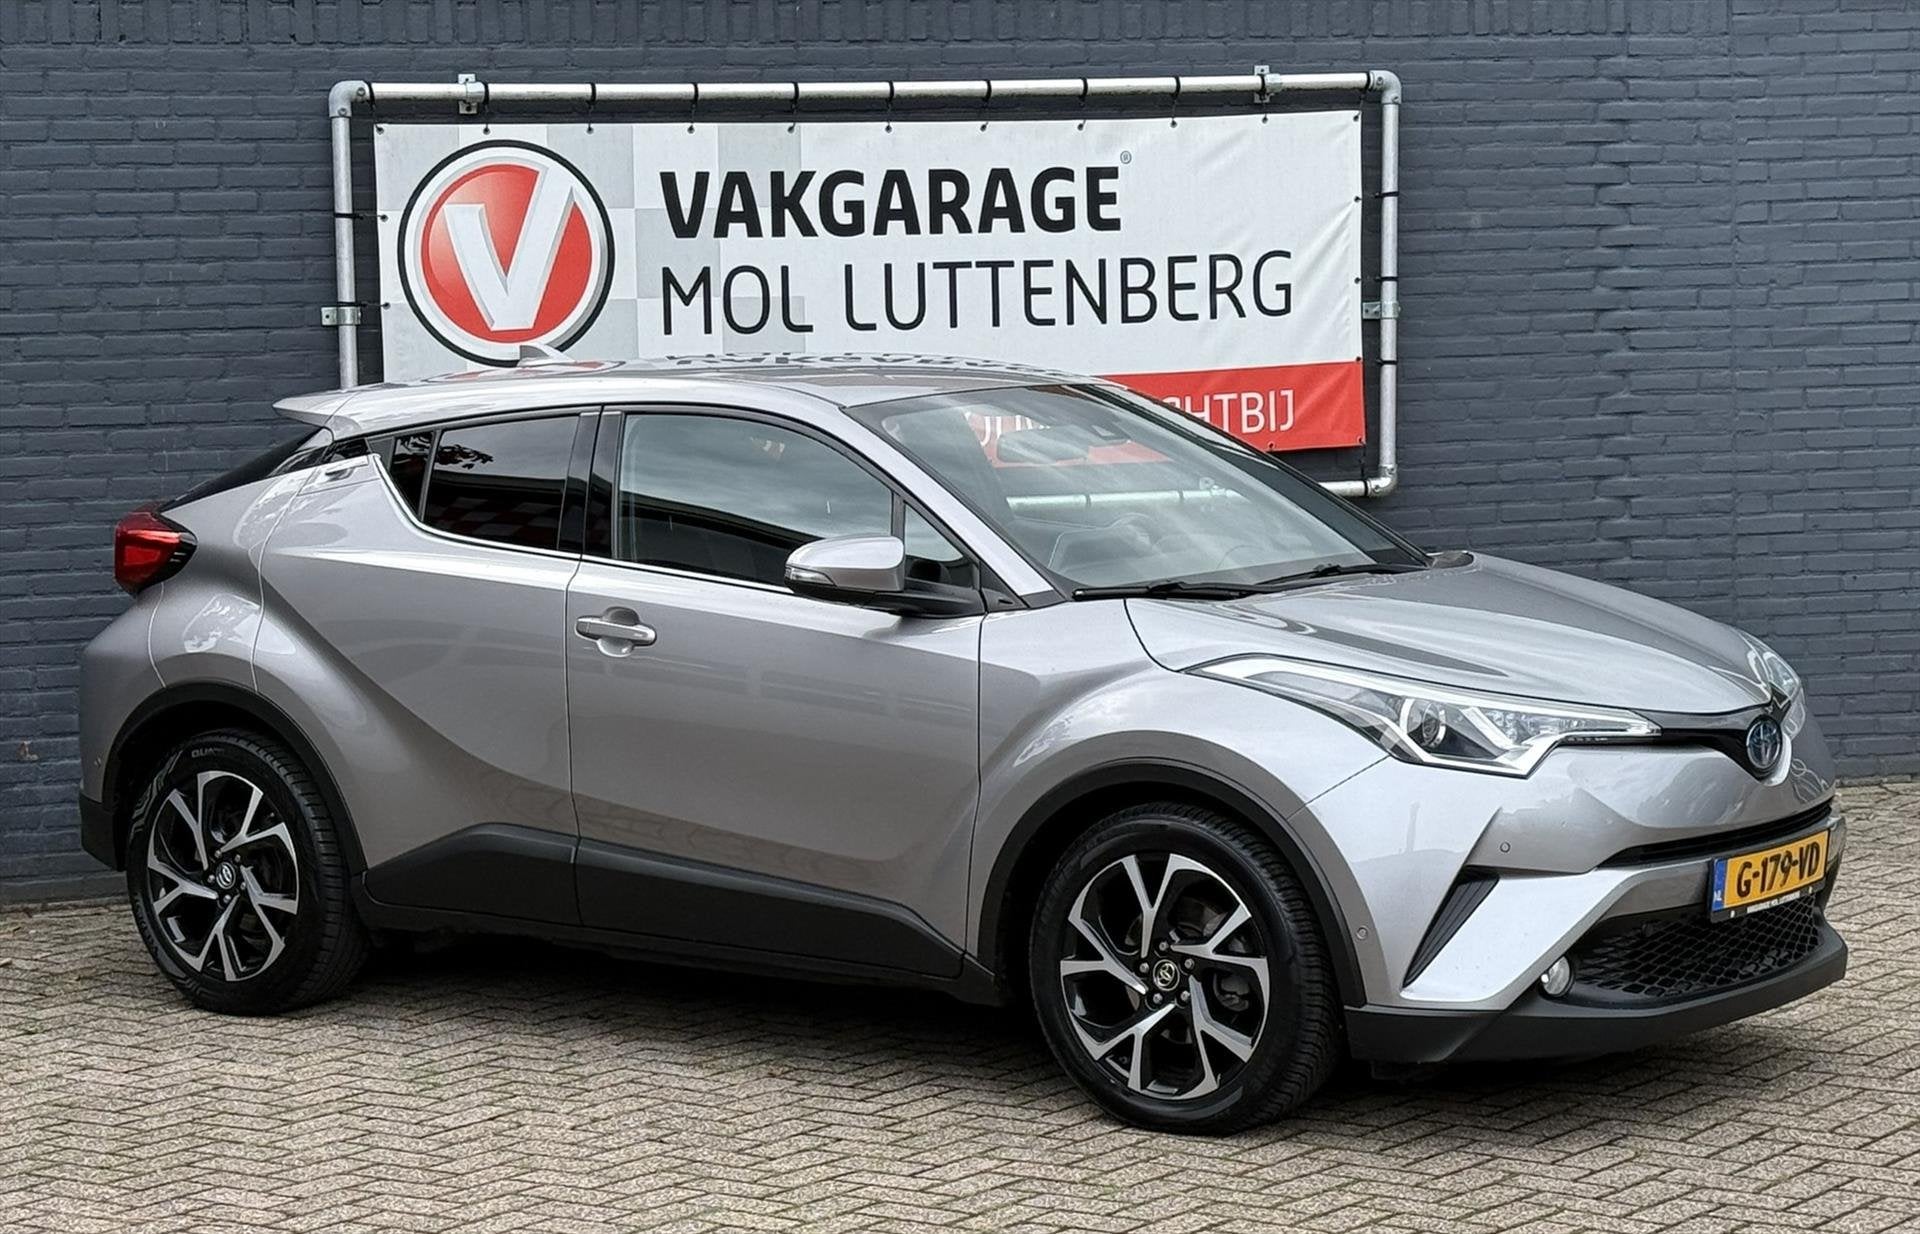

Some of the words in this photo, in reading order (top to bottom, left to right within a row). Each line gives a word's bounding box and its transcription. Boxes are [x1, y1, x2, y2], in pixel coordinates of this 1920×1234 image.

[660, 166, 1121, 239] VAKGARAGE
[662, 265, 814, 336] MOL
[844, 250, 1292, 331] LUTTENBERG
[1736, 841, 1821, 898] G-179-VD
